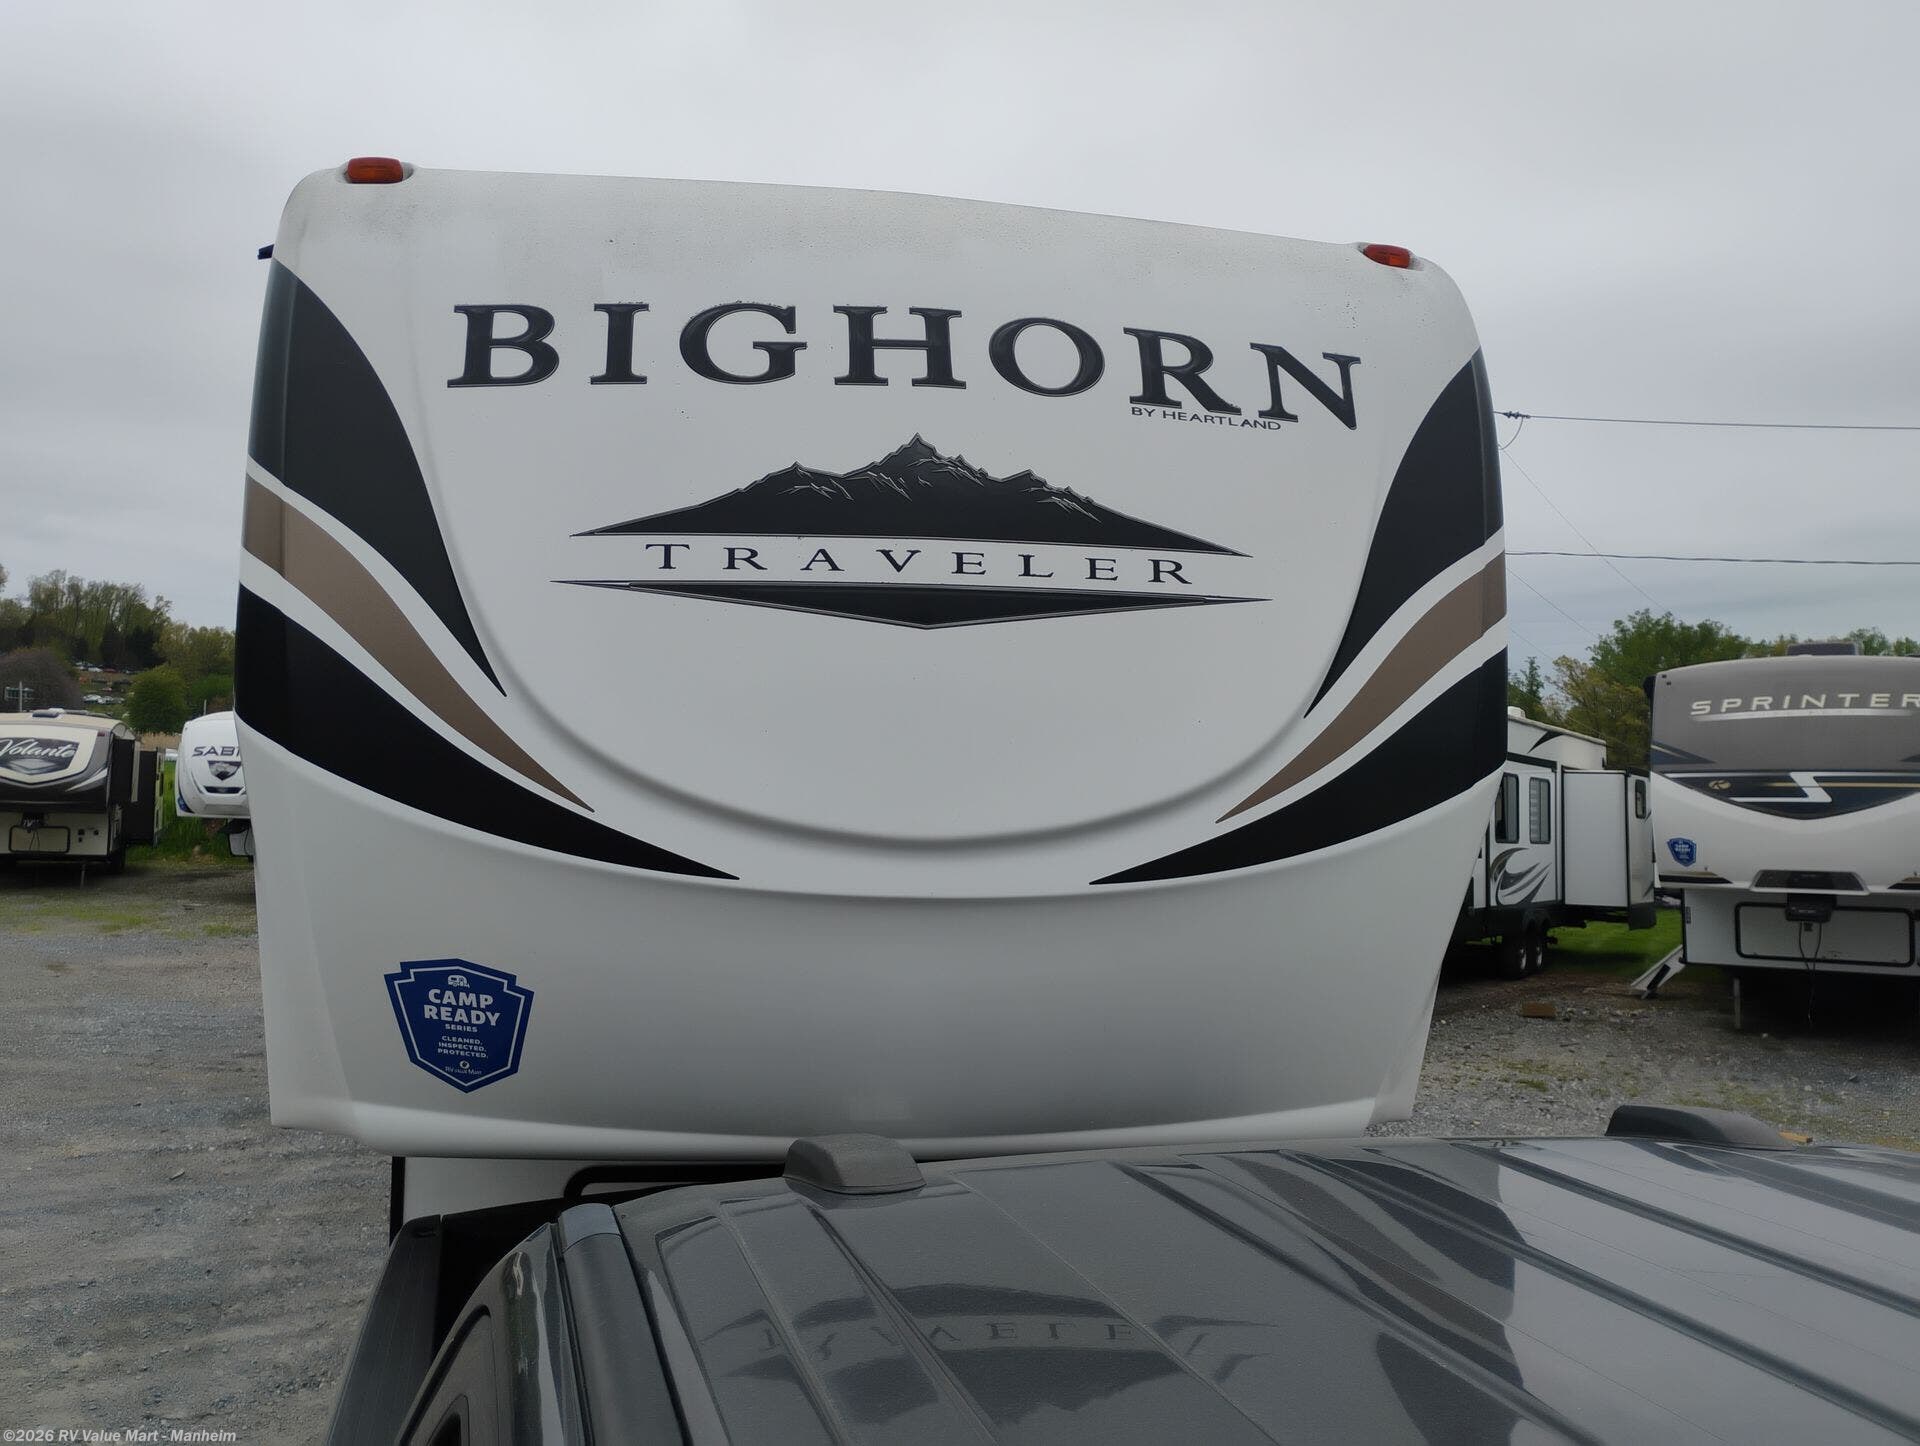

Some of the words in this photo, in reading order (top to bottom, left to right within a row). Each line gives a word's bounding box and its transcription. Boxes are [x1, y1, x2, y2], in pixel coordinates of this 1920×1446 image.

[447, 302, 1361, 430] BIGHORN
[1131, 406, 1155, 418] BY
[1163, 410, 1281, 431] HEARTLAND
[645, 543, 1192, 585] TRAVELER
[1690, 693, 1920, 715] SPRINTER
[428, 988, 493, 1009] CAMP
[424, 1004, 500, 1026] READY
[445, 1023, 478, 1032] SERIES
